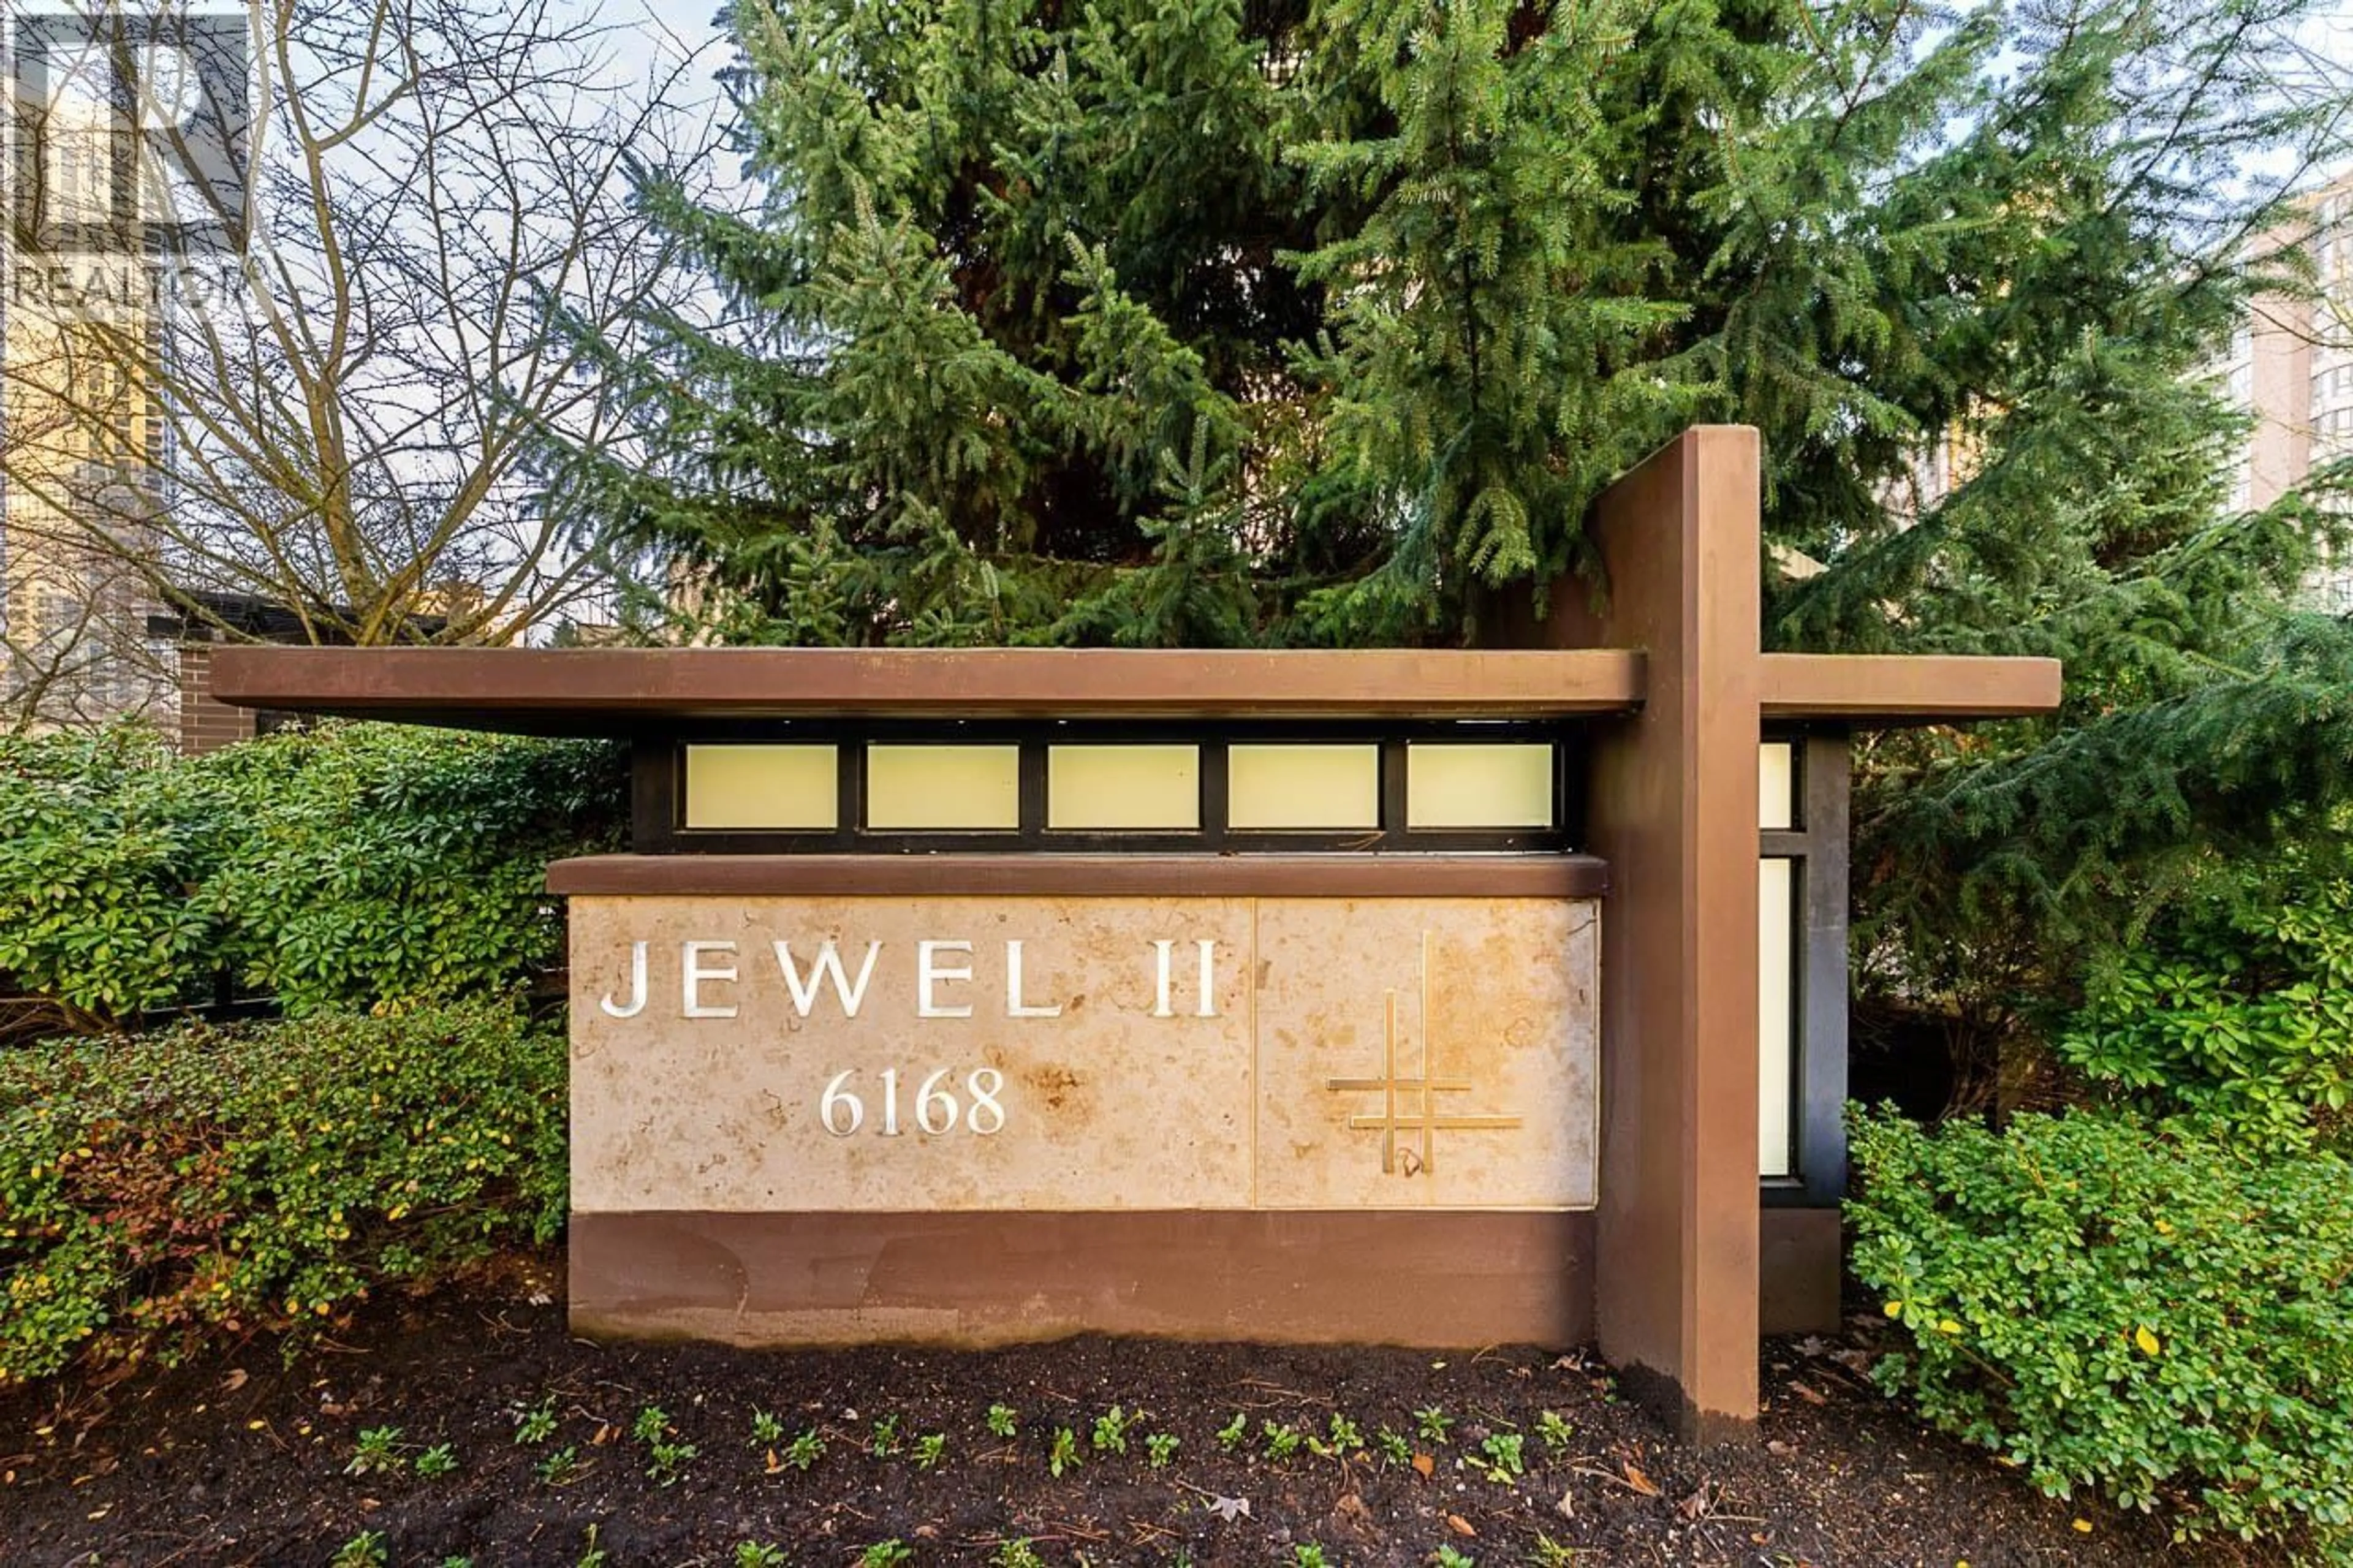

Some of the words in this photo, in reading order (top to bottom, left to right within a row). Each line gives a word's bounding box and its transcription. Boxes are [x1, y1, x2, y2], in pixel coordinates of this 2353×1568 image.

[599, 939, 1063, 1018] JEWEL
[1148, 939, 1219, 1017] II
[820, 1066, 1007, 1137] 6168
